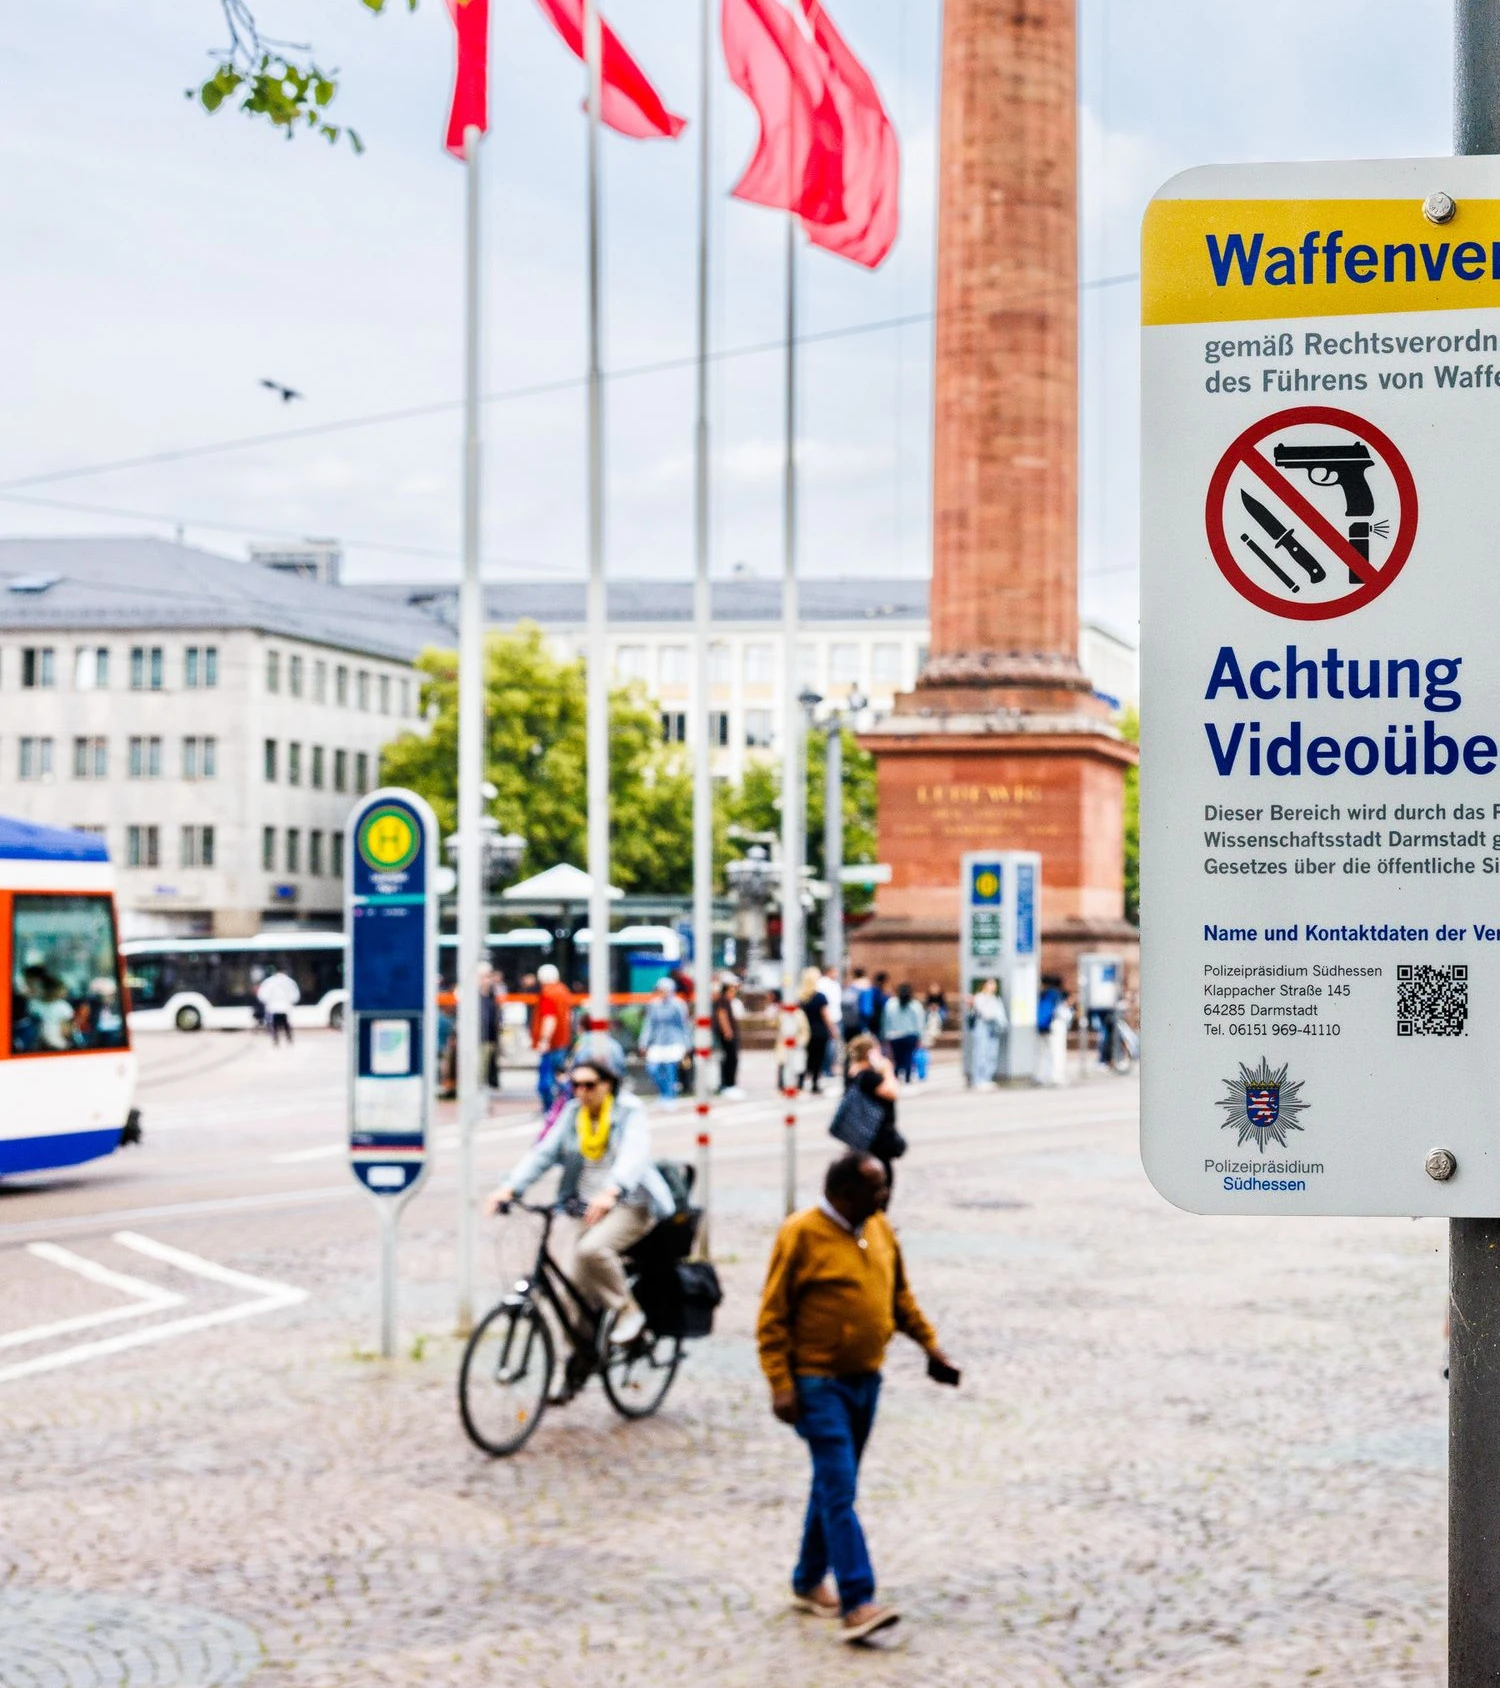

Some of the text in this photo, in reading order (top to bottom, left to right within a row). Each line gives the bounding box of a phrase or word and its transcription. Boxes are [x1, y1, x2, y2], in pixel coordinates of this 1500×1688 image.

[1204, 332, 1294, 365] gemäß
[1205, 369, 1252, 394] des
[1262, 368, 1368, 393] Führens
[1378, 372, 1424, 390] von
[1204, 644, 1463, 713] Achtung
[1204, 804, 1264, 822] Dieser
[1270, 803, 1341, 821] Bereich
[1346, 803, 1387, 821] wird
[1393, 803, 1446, 821] durch
[1452, 803, 1486, 820] das
[1203, 830, 1382, 848] Wissenschaftsstadt
[1388, 830, 1487, 848] Darmstadt
[1204, 857, 1288, 875] Gesetzes
[1294, 857, 1336, 875] über
[1342, 857, 1371, 875] die
[1377, 857, 1476, 875] öffentliche
[1204, 924, 1258, 942] Name
[1264, 924, 1298, 942] und
[1305, 924, 1429, 942] Kontaktdaten
[1435, 924, 1467, 942] der
[1204, 964, 1383, 979] Polizeipräsidium Südhessen
[1204, 984, 1351, 999] Klappacher Straße 145
[1203, 1003, 1318, 1016] 64285 Darmstadt
[1203, 1023, 1341, 1036] Tel. 06151 969-41110
[1204, 1159, 1324, 1177] Polizeipräsidium
[1223, 1176, 1306, 1191] Südhessen
